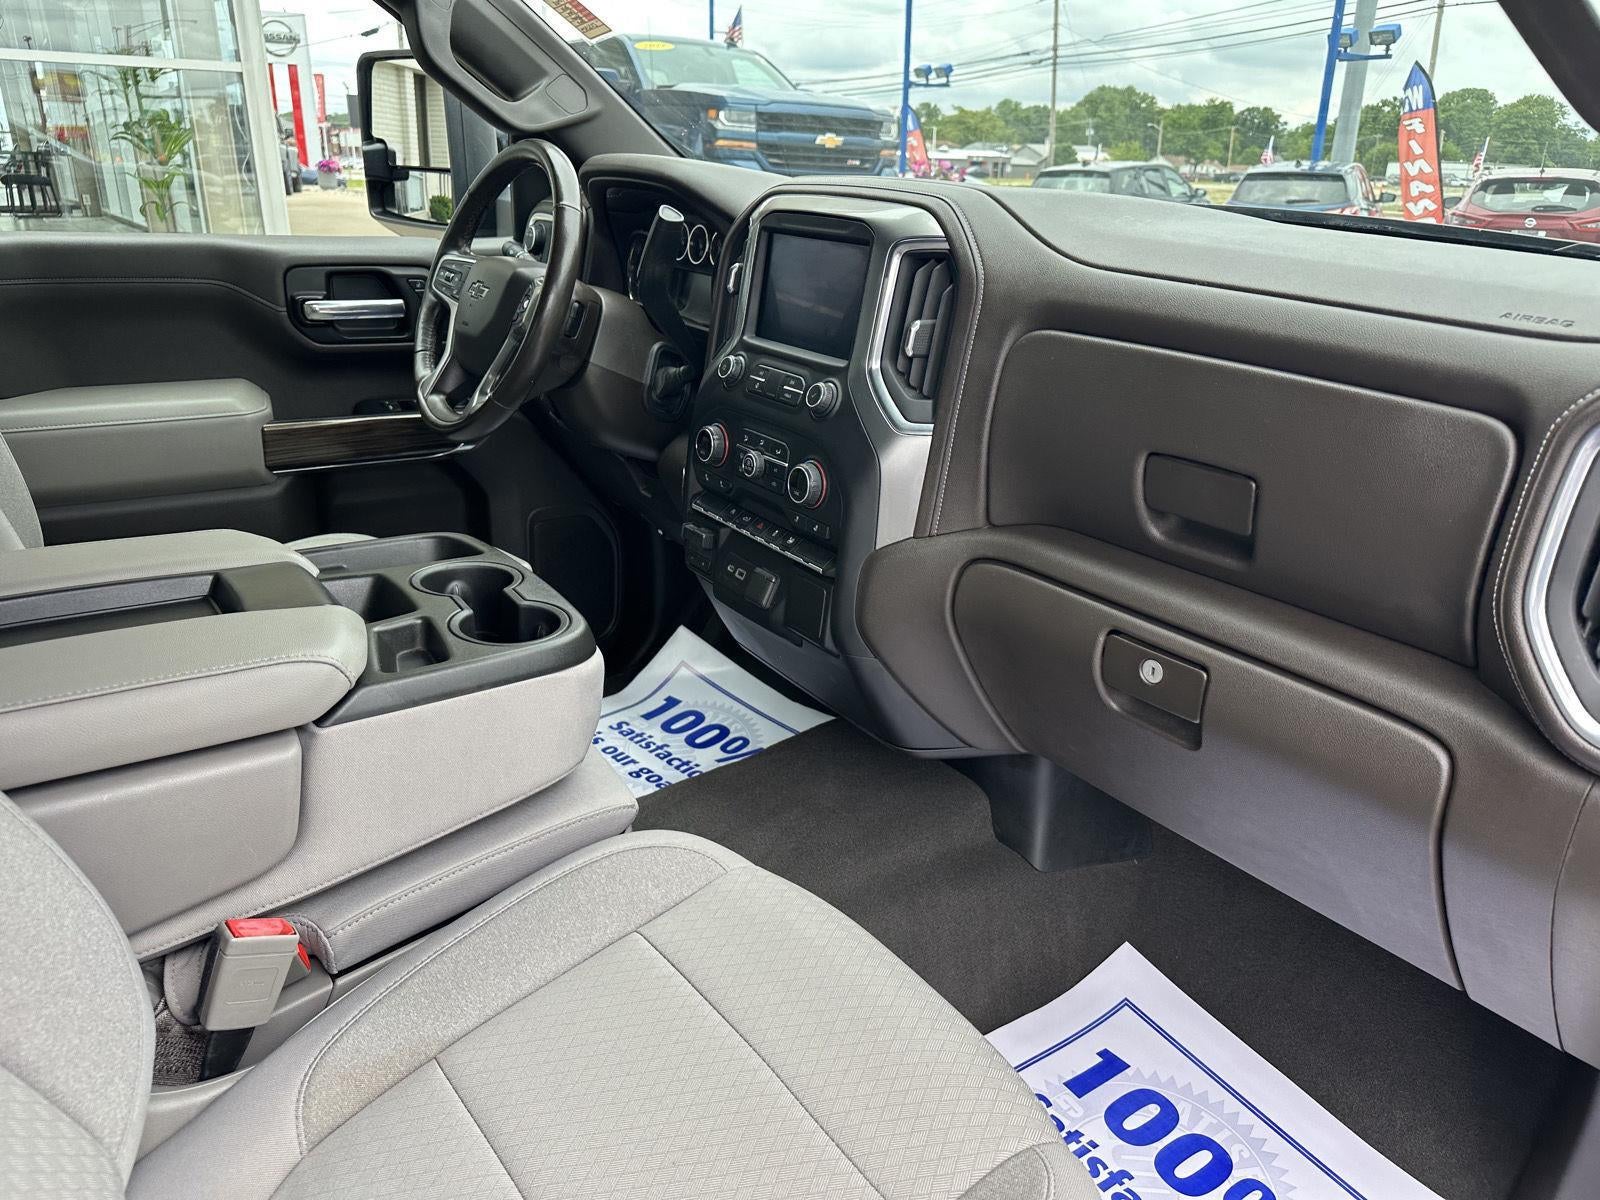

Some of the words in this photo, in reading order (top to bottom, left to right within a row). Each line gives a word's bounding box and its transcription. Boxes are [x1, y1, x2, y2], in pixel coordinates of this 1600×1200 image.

[1499, 312, 1575, 328] AIRBAG
[592, 731, 605, 745] s
[601, 745, 640, 766] our
